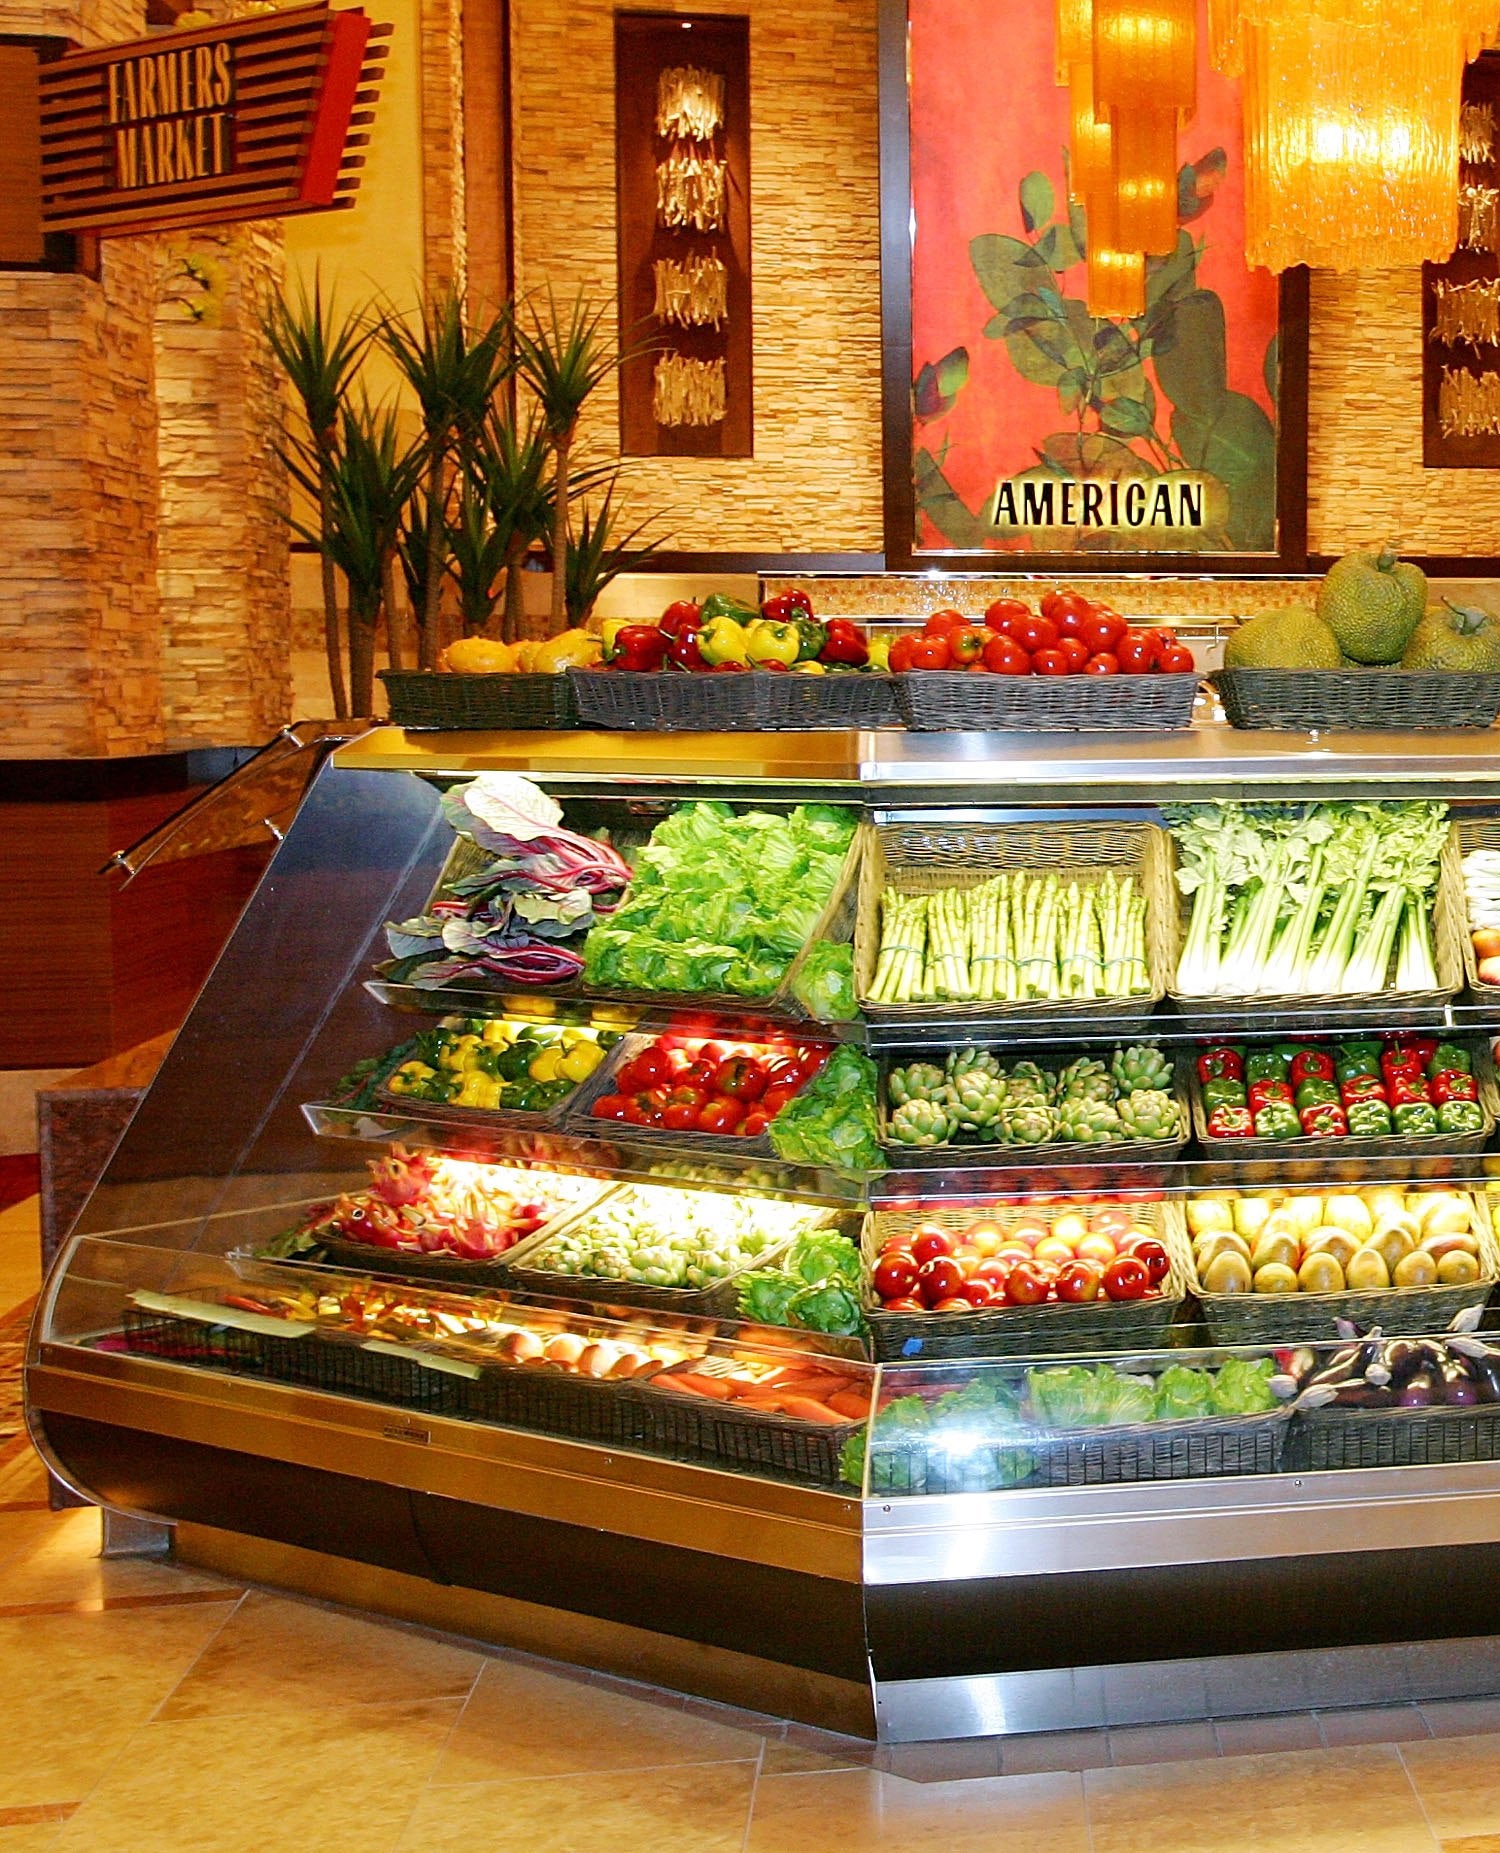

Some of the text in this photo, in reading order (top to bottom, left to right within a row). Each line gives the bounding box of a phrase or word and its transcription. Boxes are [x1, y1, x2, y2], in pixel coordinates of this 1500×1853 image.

[108, 42, 231, 124] FARMERS
[116, 112, 226, 188] MARKET
[993, 481, 1202, 527] AMERICAN
